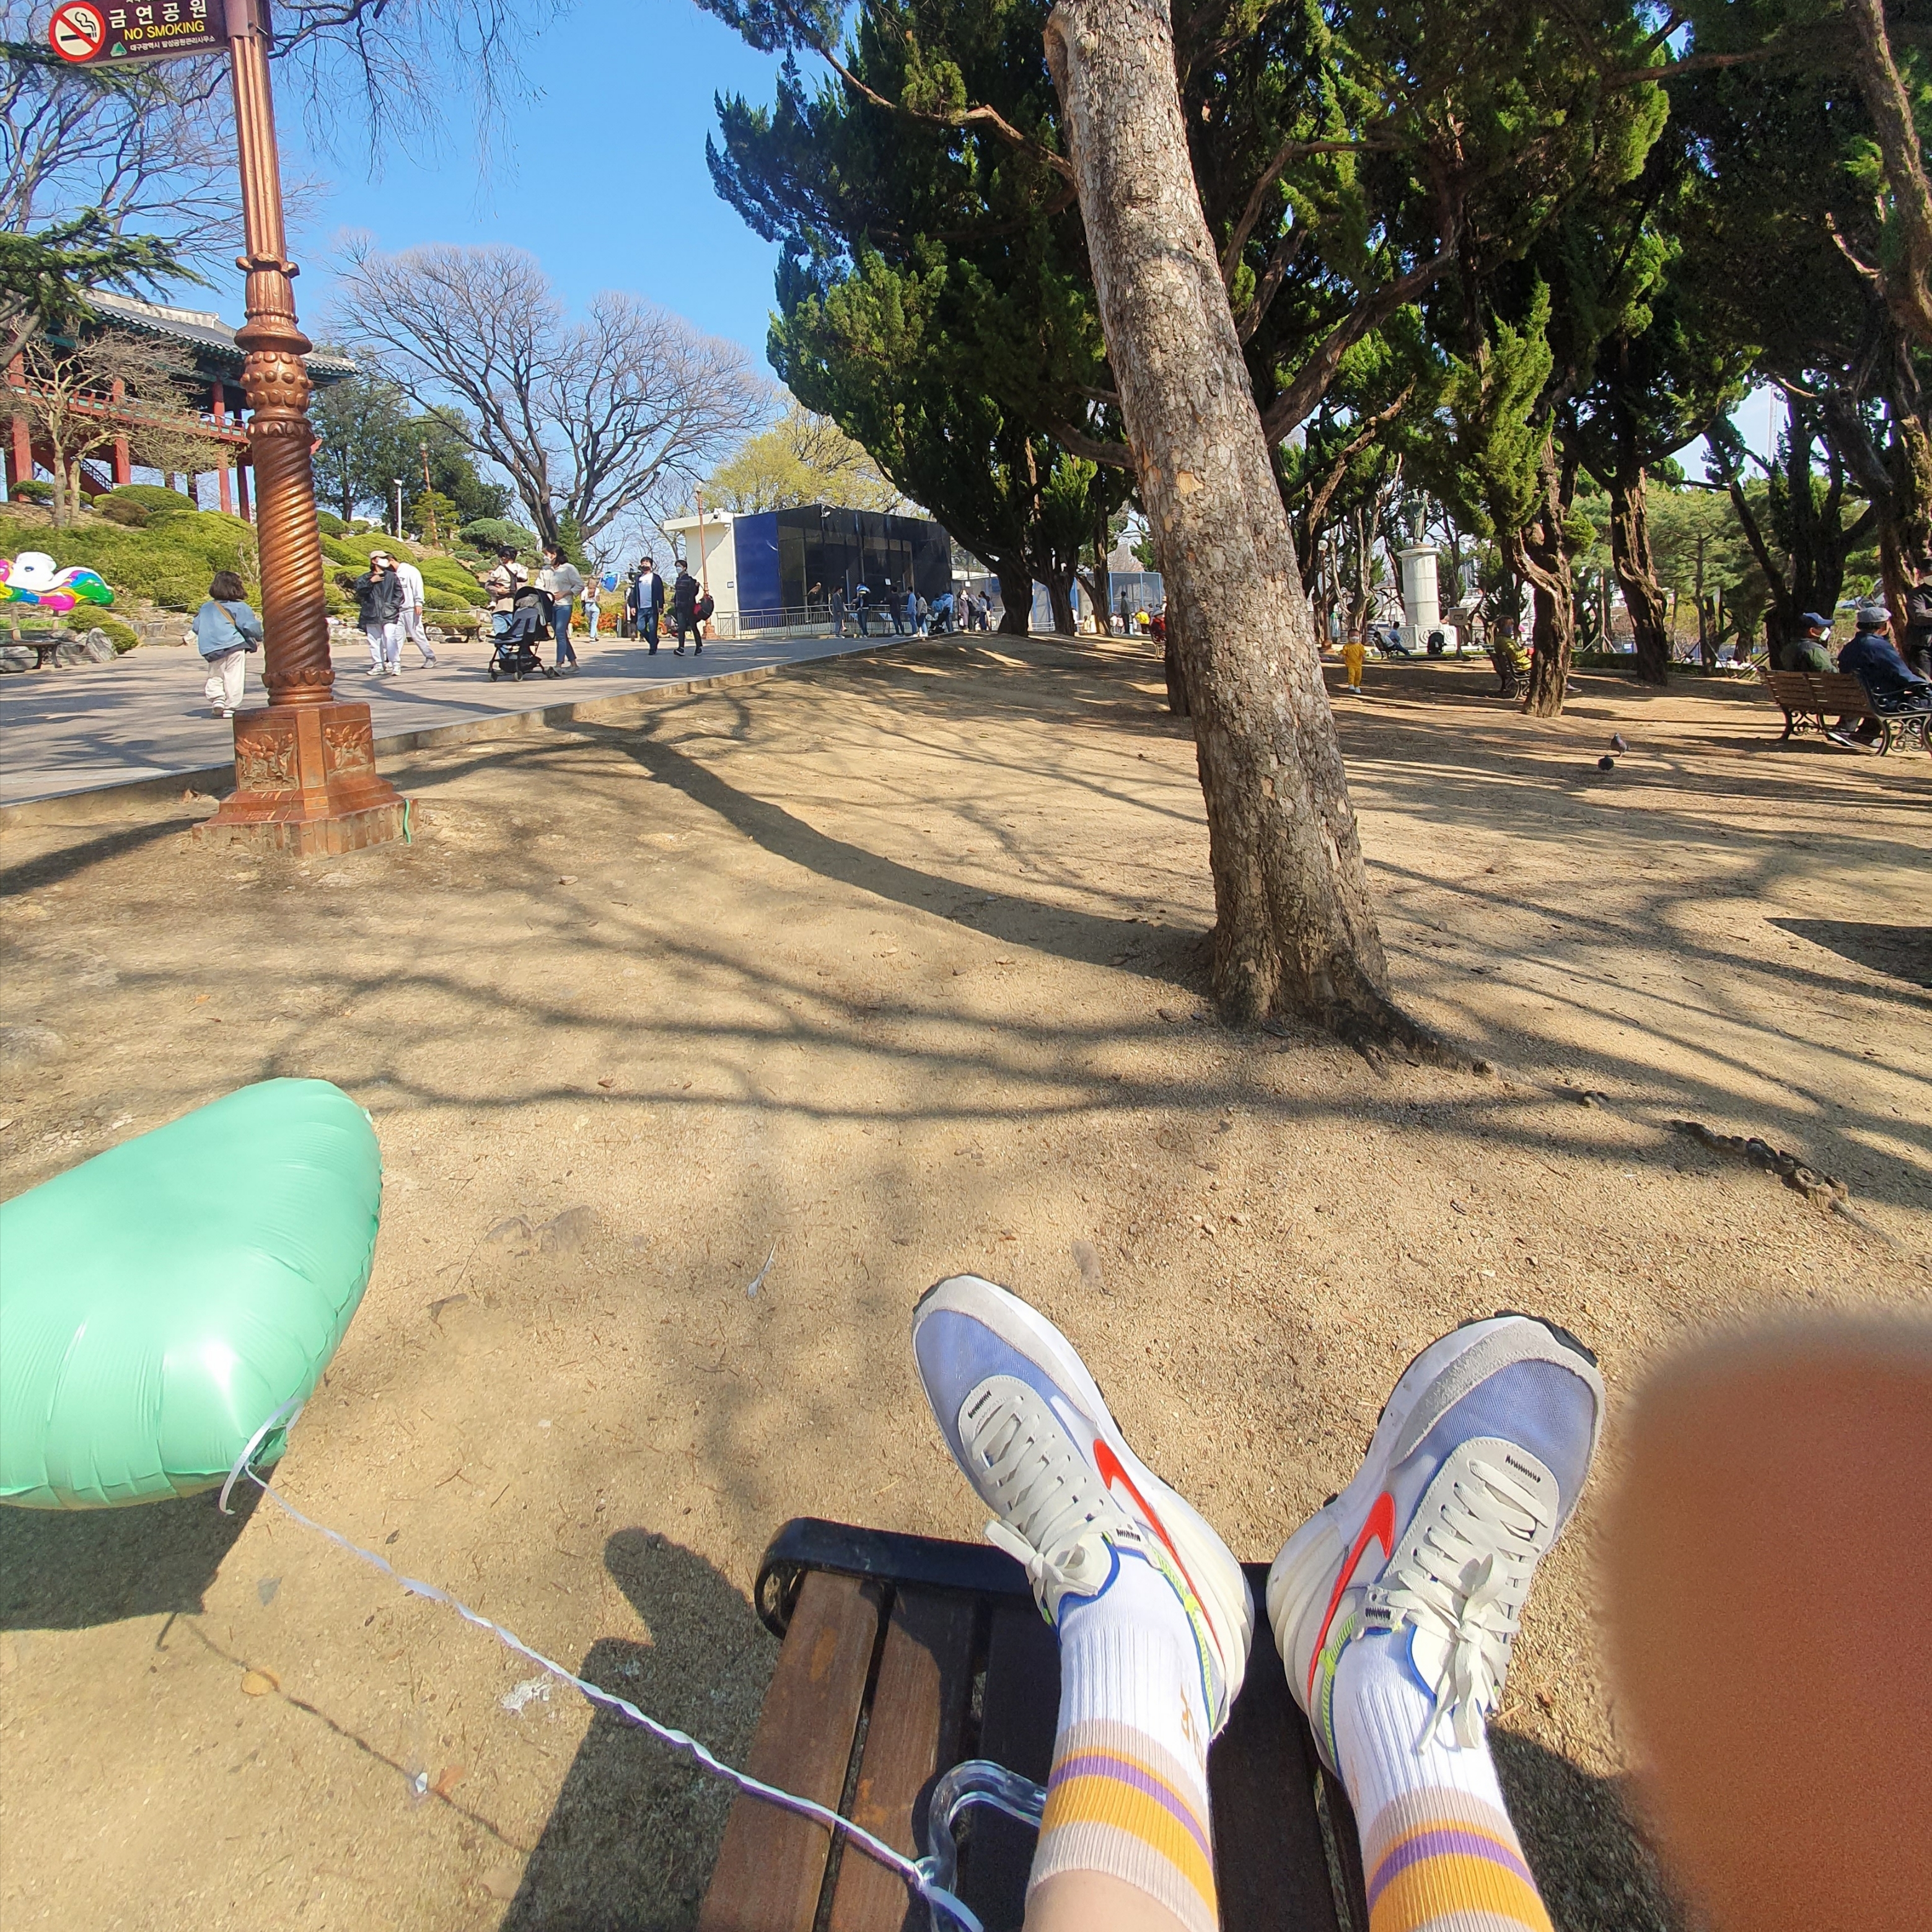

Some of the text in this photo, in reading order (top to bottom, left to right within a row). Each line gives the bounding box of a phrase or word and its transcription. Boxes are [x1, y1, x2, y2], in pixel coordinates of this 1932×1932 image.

[123, 20, 205, 41] NO SMOKING
[130, 42, 160, 51] 대구광역시
